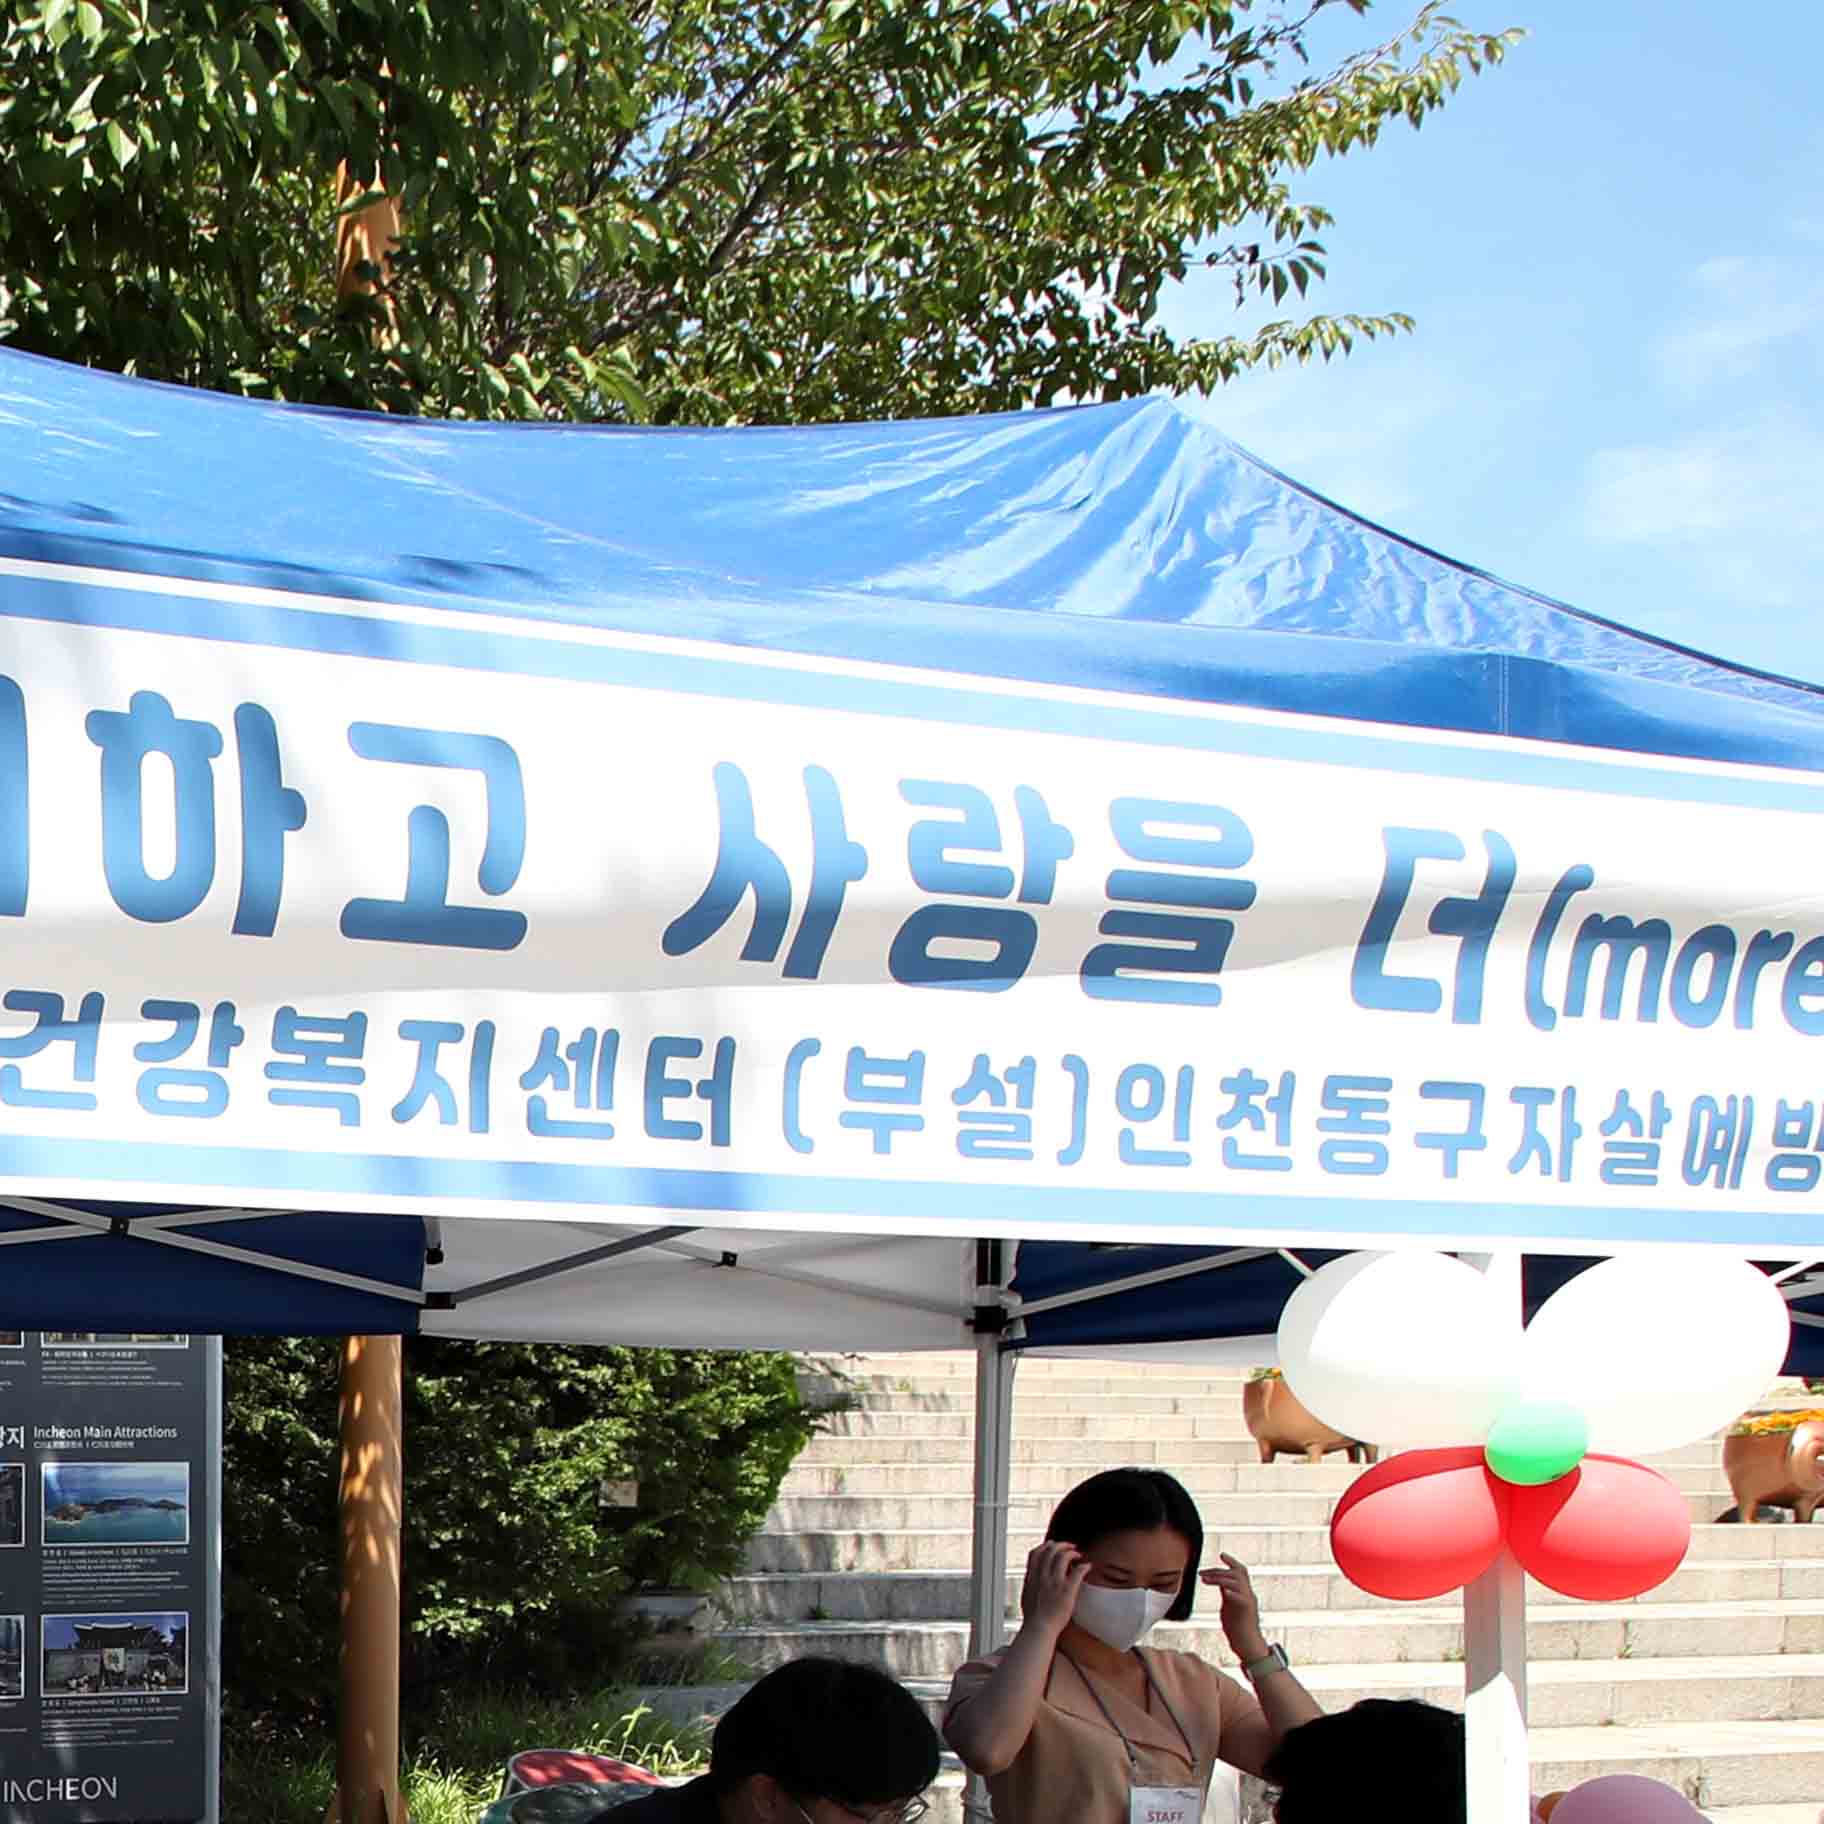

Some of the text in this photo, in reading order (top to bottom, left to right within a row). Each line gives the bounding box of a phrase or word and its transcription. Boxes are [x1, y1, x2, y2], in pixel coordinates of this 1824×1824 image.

[661, 760, 1257, 1008] 사랑을
[34, 1426, 81, 1440] Incheon
[84, 1426, 112, 1440] Main
[114, 1425, 178, 1441] Attractions
[3, 1776, 118, 1803] INCHEON
[1147, 1809, 1185, 1824] STAFF
